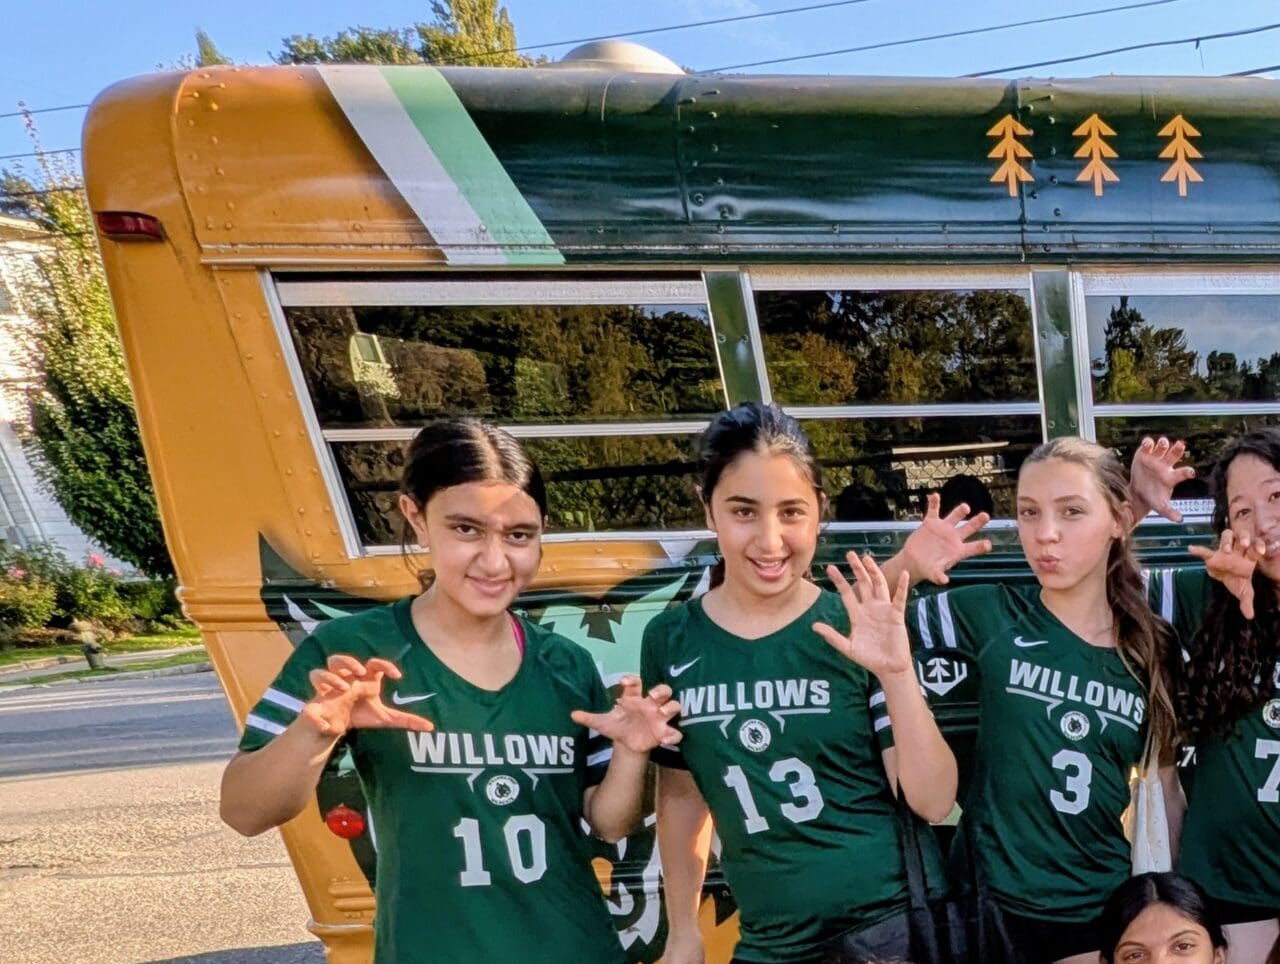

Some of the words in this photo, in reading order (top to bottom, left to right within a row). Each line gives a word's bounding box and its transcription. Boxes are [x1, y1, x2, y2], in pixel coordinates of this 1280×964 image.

[680, 679, 830, 717] WILLOWS
[1009, 658, 1145, 725] WILLOWS
[407, 731, 575, 765] WILLOWS
[724, 757, 824, 834] 13
[1050, 749, 1093, 815] 3
[453, 814, 547, 887] 10
